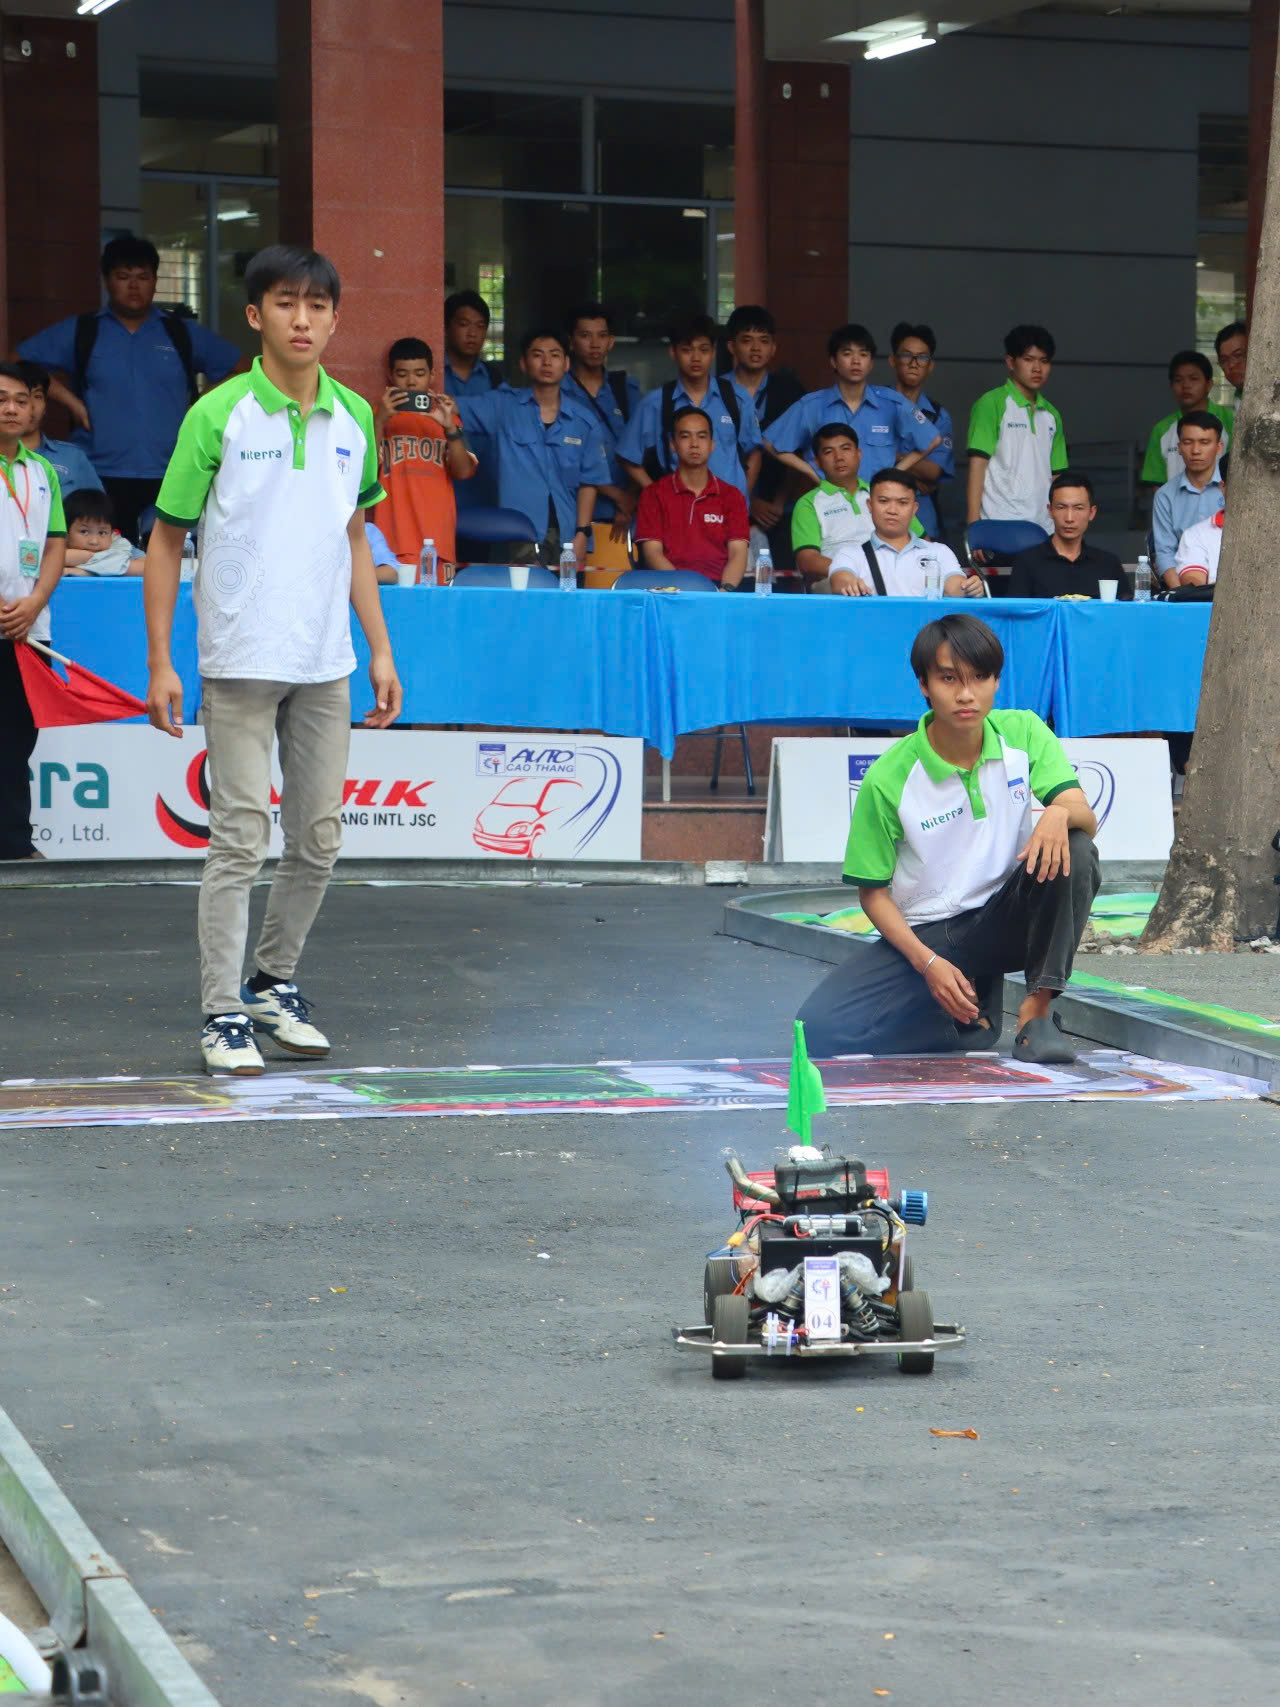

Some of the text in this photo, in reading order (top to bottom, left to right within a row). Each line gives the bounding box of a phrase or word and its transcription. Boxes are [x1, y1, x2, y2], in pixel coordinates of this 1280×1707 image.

[510, 747, 575, 764] AUTO
[506, 763, 575, 773] CAO THANG
[373, 813, 405, 826] INTL
[409, 813, 437, 827] JSC
[920, 806, 964, 832] Niterra
[72, 823, 110, 841] Ltd.
[811, 1314, 833, 1329] 04
